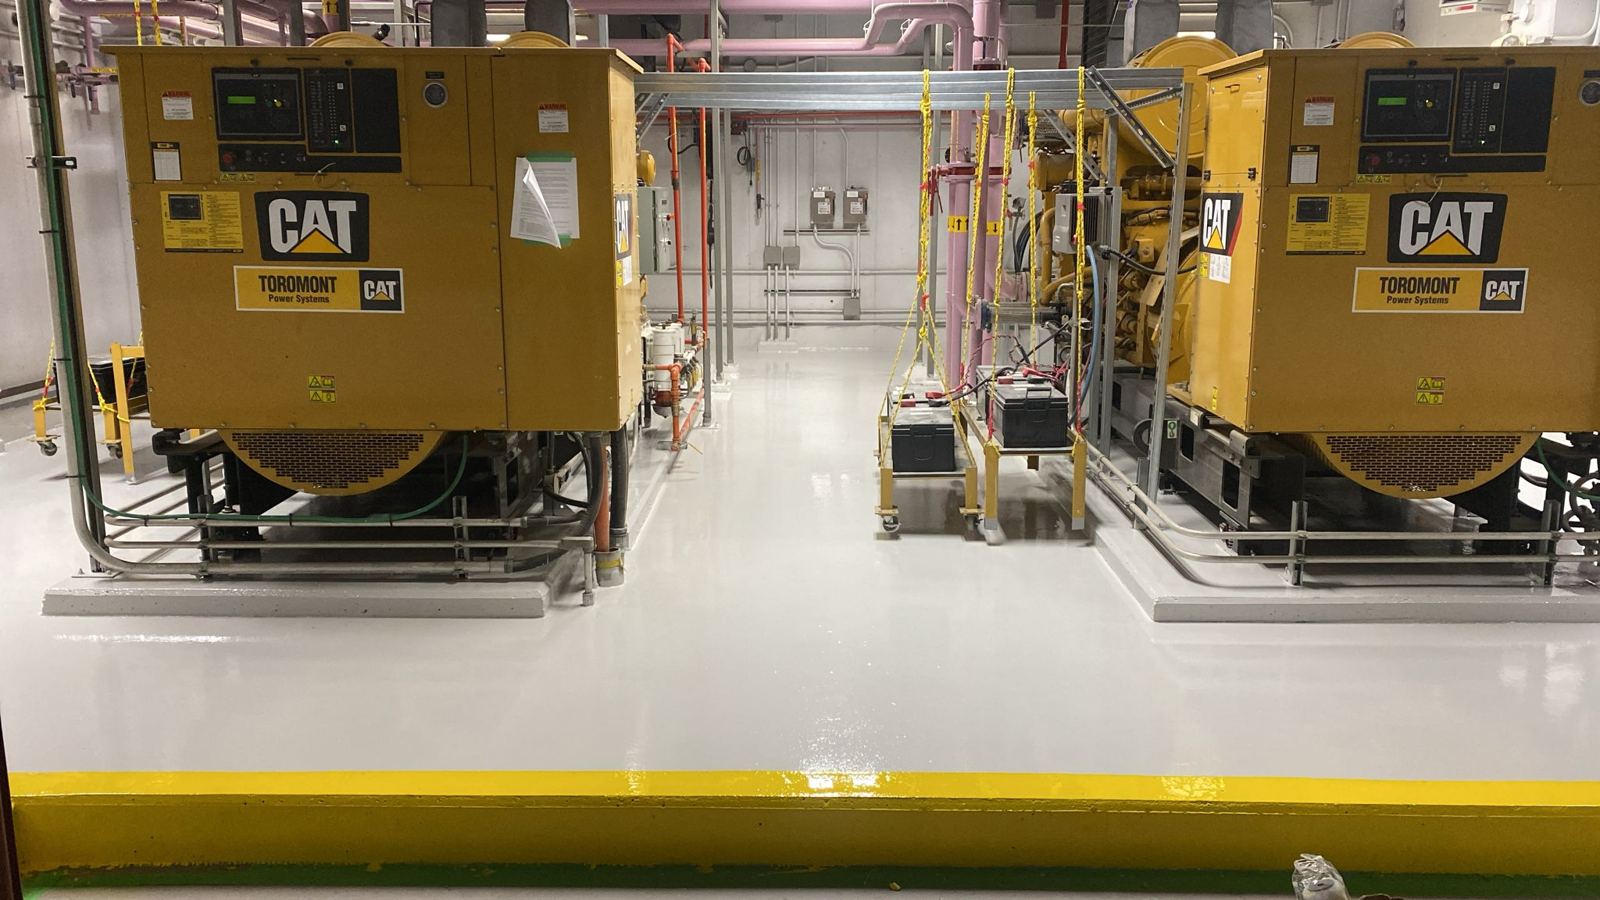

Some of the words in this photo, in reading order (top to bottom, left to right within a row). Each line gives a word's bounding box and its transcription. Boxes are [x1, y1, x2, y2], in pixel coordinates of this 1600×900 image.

[269, 199, 357, 253] CAT
[1203, 199, 1231, 249] CAT
[1399, 202, 1493, 255] CAT
[259, 276, 337, 293] TOROMONT
[364, 281, 396, 300] CAT
[1380, 277, 1460, 294] TOROMONT
[1486, 281, 1520, 300] CAT
[269, 295, 294, 303] Power
[296, 295, 330, 304] Systems
[1386, 296, 1412, 304] Power
[1414, 296, 1449, 305] Systems
